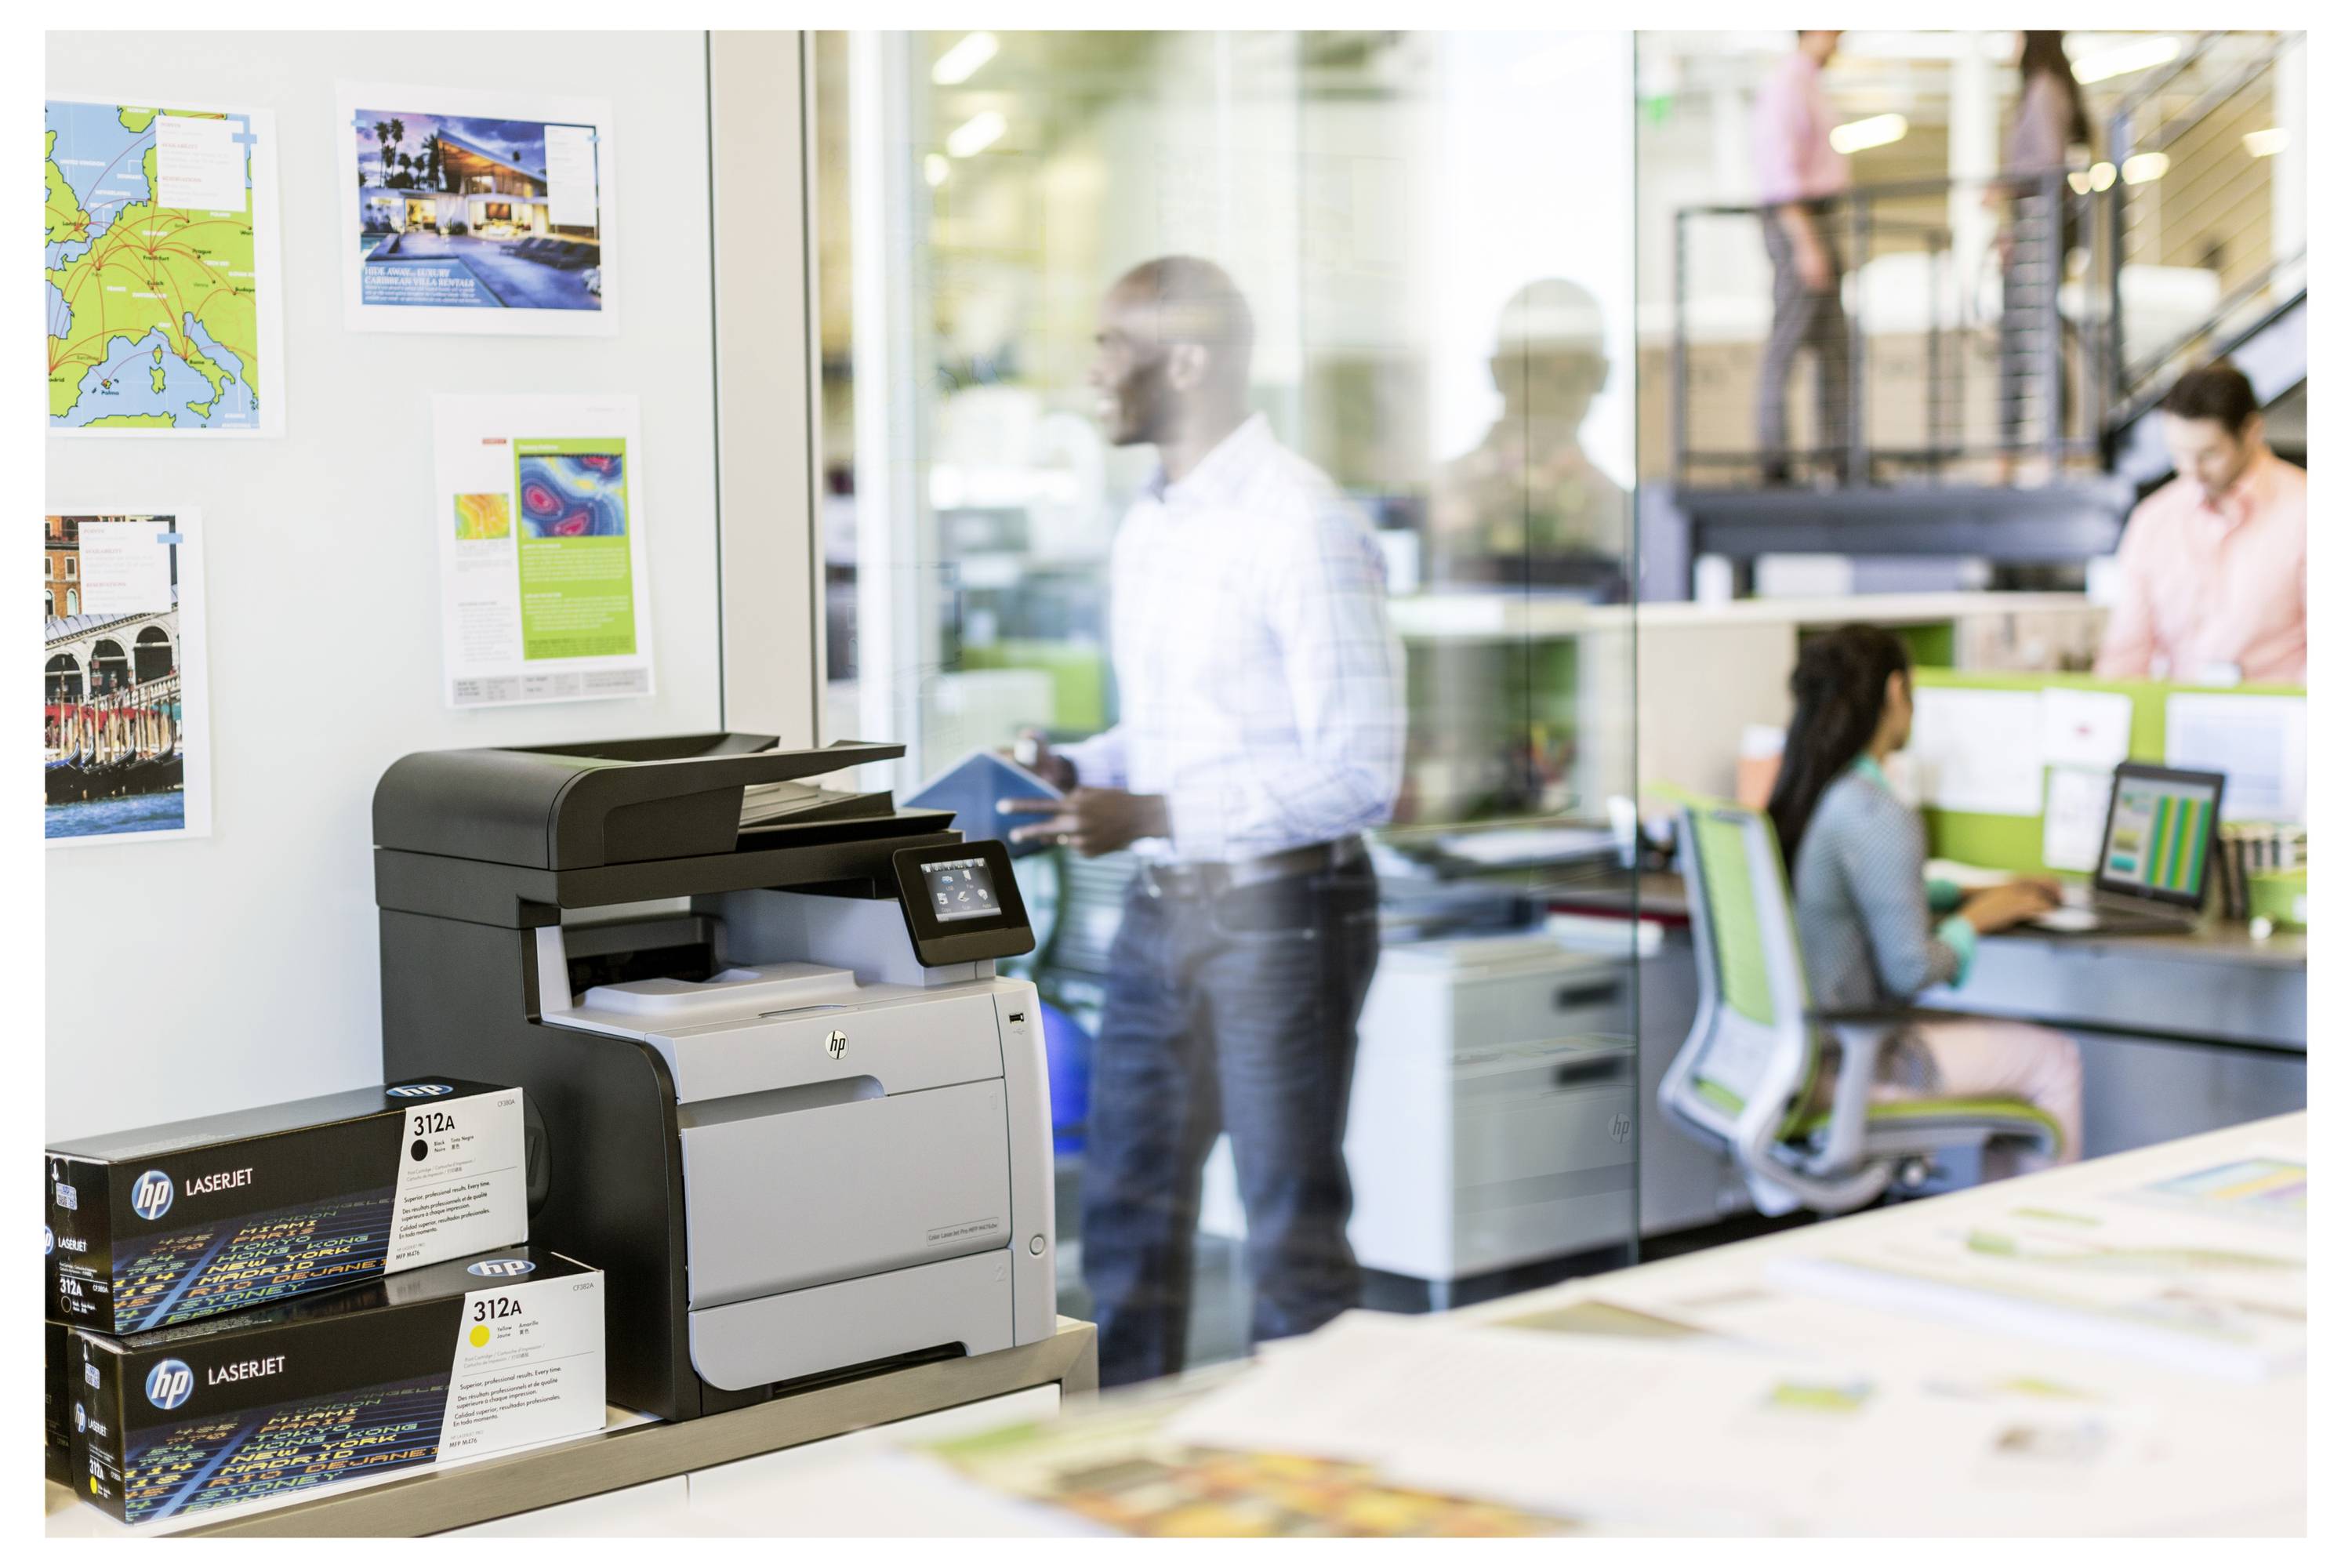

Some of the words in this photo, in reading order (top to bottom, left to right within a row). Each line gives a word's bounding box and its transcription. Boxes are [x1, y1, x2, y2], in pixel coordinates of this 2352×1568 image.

[829, 1030, 846, 1059] hp
[394, 1084, 443, 1097] hp
[414, 1112, 456, 1136] 312A
[1612, 1113, 1630, 1144] hp
[186, 1168, 253, 1196] LASERJET
[424, 1189, 452, 1200] professional
[467, 1182, 480, 1192] Every
[136, 1171, 170, 1220] hp
[430, 1197, 462, 1210] professionnels
[429, 1207, 446, 1218] chaque
[239, 1219, 318, 1236] MIAMI
[400, 1223, 418, 1232] Calidad
[437, 1214, 460, 1224] resultados
[58, 1236, 87, 1252] LASERJET
[228, 1236, 312, 1253] TOKYO
[232, 1226, 317, 1244] PARIS
[216, 1247, 290, 1263] HONG
[306, 1235, 369, 1250] KONG
[395, 1252, 406, 1261] MFP
[207, 1258, 267, 1275] NEW
[285, 1247, 351, 1261] YORK
[478, 1260, 526, 1276] hp
[198, 1261, 314, 1287] MADRID
[60, 1278, 82, 1297] 312A
[177, 1281, 306, 1311] SYDNEY
[187, 1281, 252, 1298] RIO
[572, 1283, 594, 1291] CF382A
[474, 1298, 522, 1322] 312A
[519, 1319, 539, 1328] Amarillo
[208, 1356, 285, 1385] LASERJET
[459, 1381, 484, 1391] Superior,
[485, 1374, 516, 1387] professional
[517, 1371, 533, 1380] results.
[535, 1368, 549, 1377] Every
[151, 1359, 190, 1410] hp
[491, 1384, 528, 1399] professionnels
[489, 1395, 508, 1406] chaque
[509, 1389, 537, 1401] impression.
[268, 1408, 358, 1425] MIAMI
[277, 1399, 382, 1417] LONDON
[454, 1411, 475, 1421] Calidad
[476, 1407, 499, 1418] superior,
[499, 1401, 525, 1412] resultados
[526, 1394, 561, 1408] profesionales.
[88, 1417, 107, 1437] LASERJET
[260, 1415, 356, 1434] PARIS
[473, 1414, 498, 1424] momento.
[241, 1436, 326, 1454] HONG
[345, 1423, 418, 1439] KONG
[255, 1424, 351, 1442] TOKYO
[230, 1448, 299, 1465] NEW
[321, 1434, 397, 1450] YORK
[449, 1440, 461, 1449] MFP
[462, 1437, 477, 1446] M476
[89, 1458, 104, 1481] 312A
[220, 1450, 354, 1476] MADRID
[195, 1471, 343, 1501] SYDNEY
[208, 1470, 282, 1489] RIO
